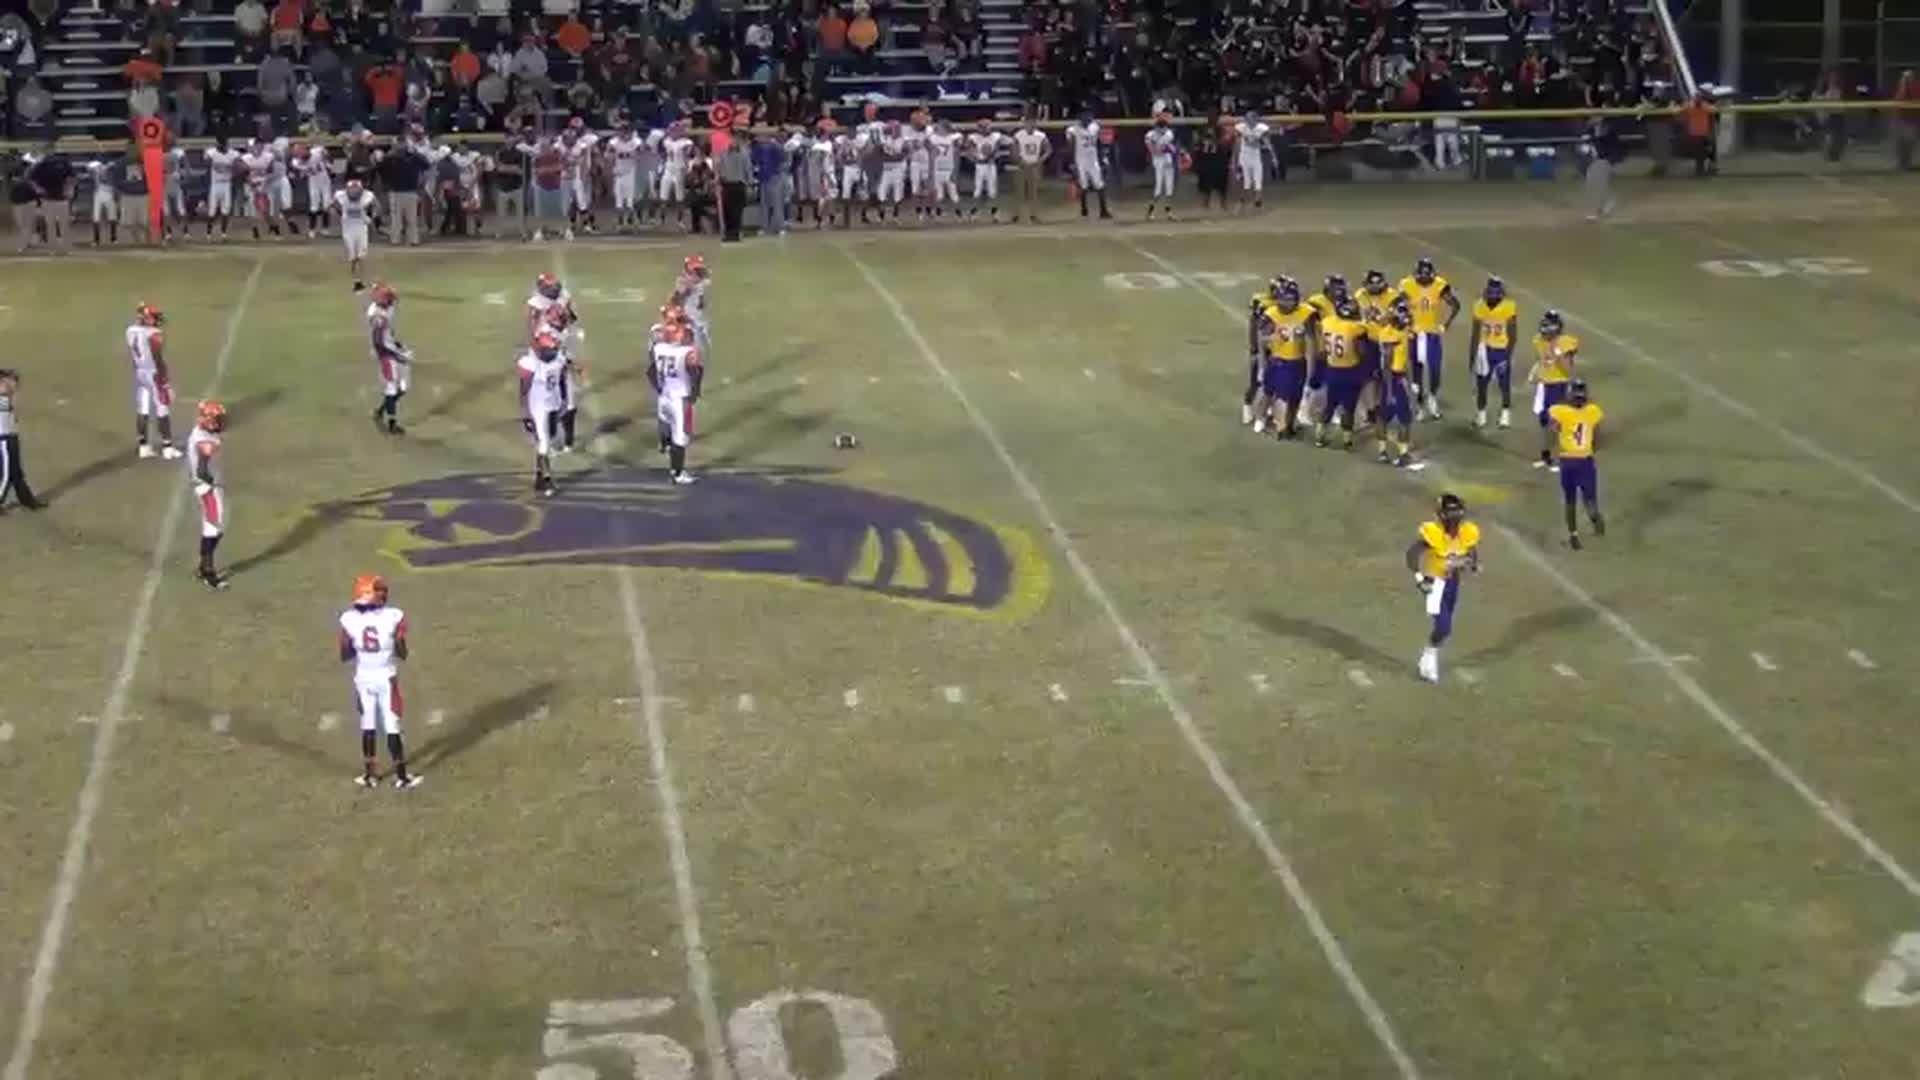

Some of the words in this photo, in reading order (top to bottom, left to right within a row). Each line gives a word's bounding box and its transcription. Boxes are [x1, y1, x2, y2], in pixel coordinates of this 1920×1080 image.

[1572, 421, 1585, 447] 4
[362, 625, 381, 653] 6
[537, 988, 898, 1080] 50
